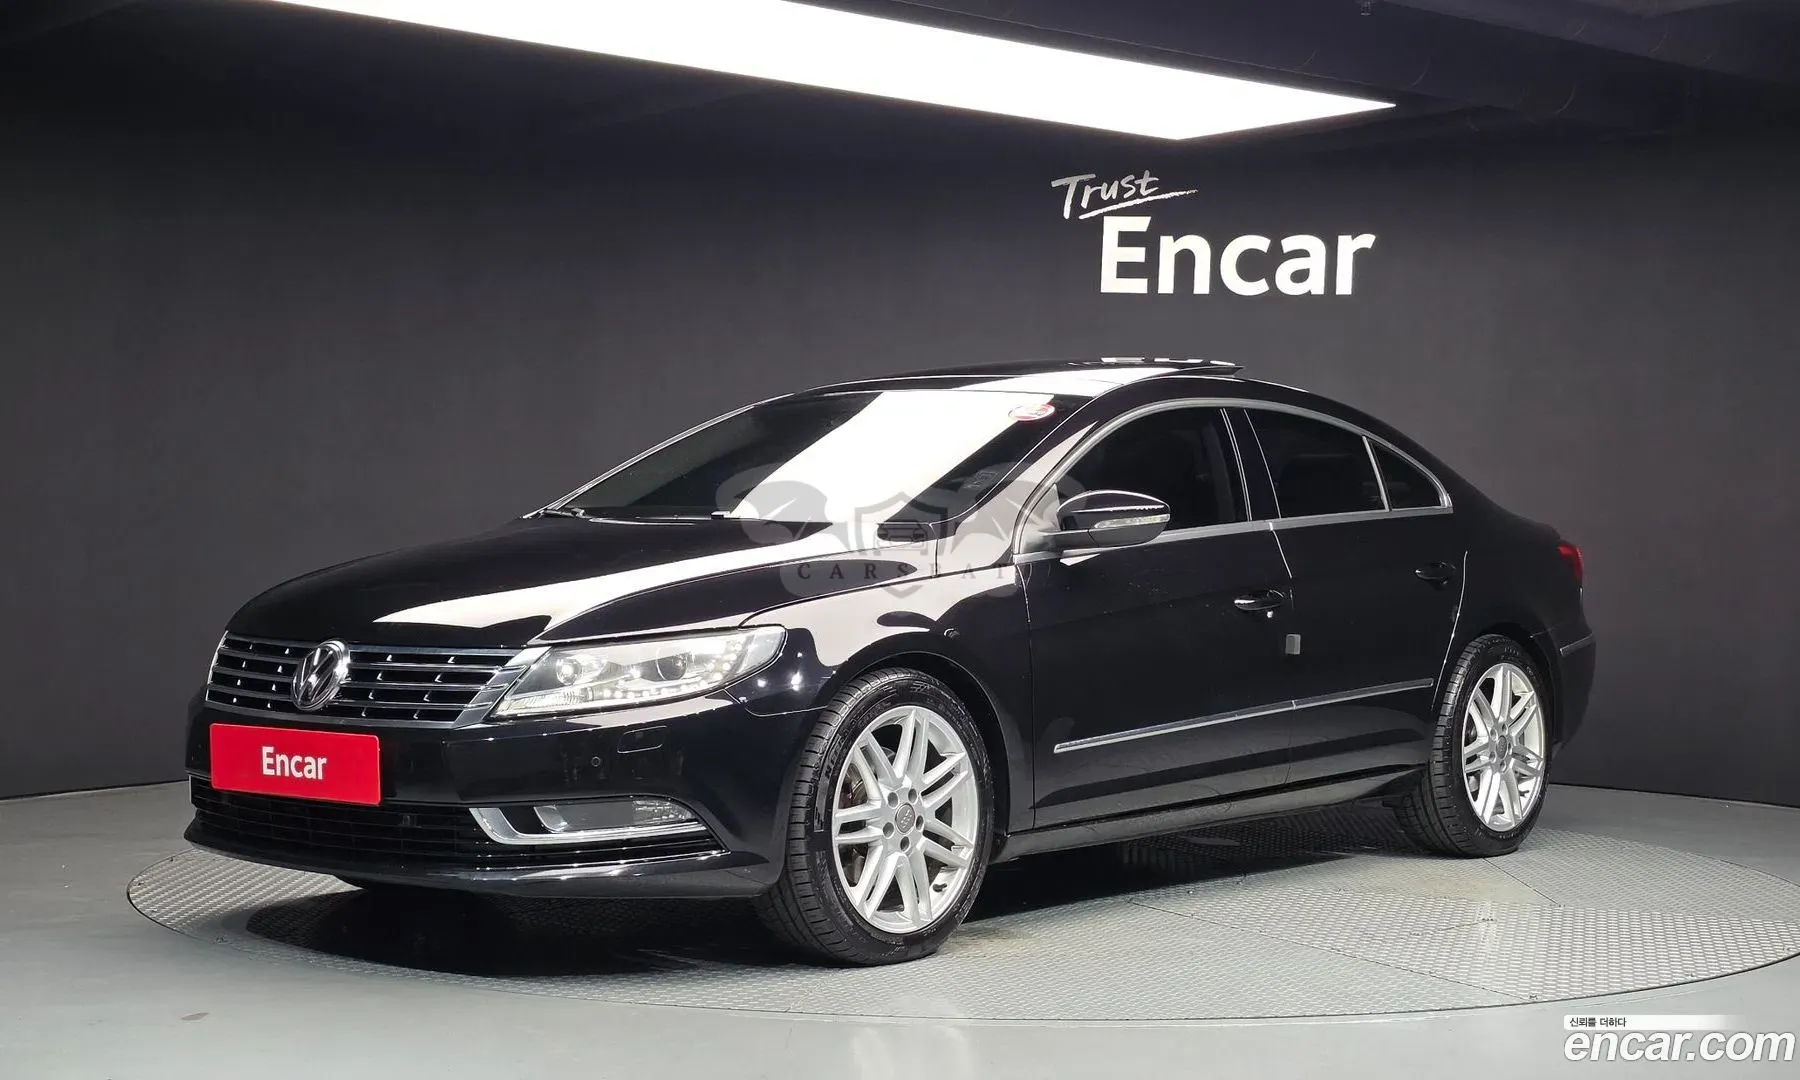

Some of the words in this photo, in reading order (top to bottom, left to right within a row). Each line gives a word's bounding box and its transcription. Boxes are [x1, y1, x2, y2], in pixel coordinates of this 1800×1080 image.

[1050, 169, 1160, 220] Trust
[1100, 215, 1377, 296] Encar
[261, 745, 328, 780] Encar
